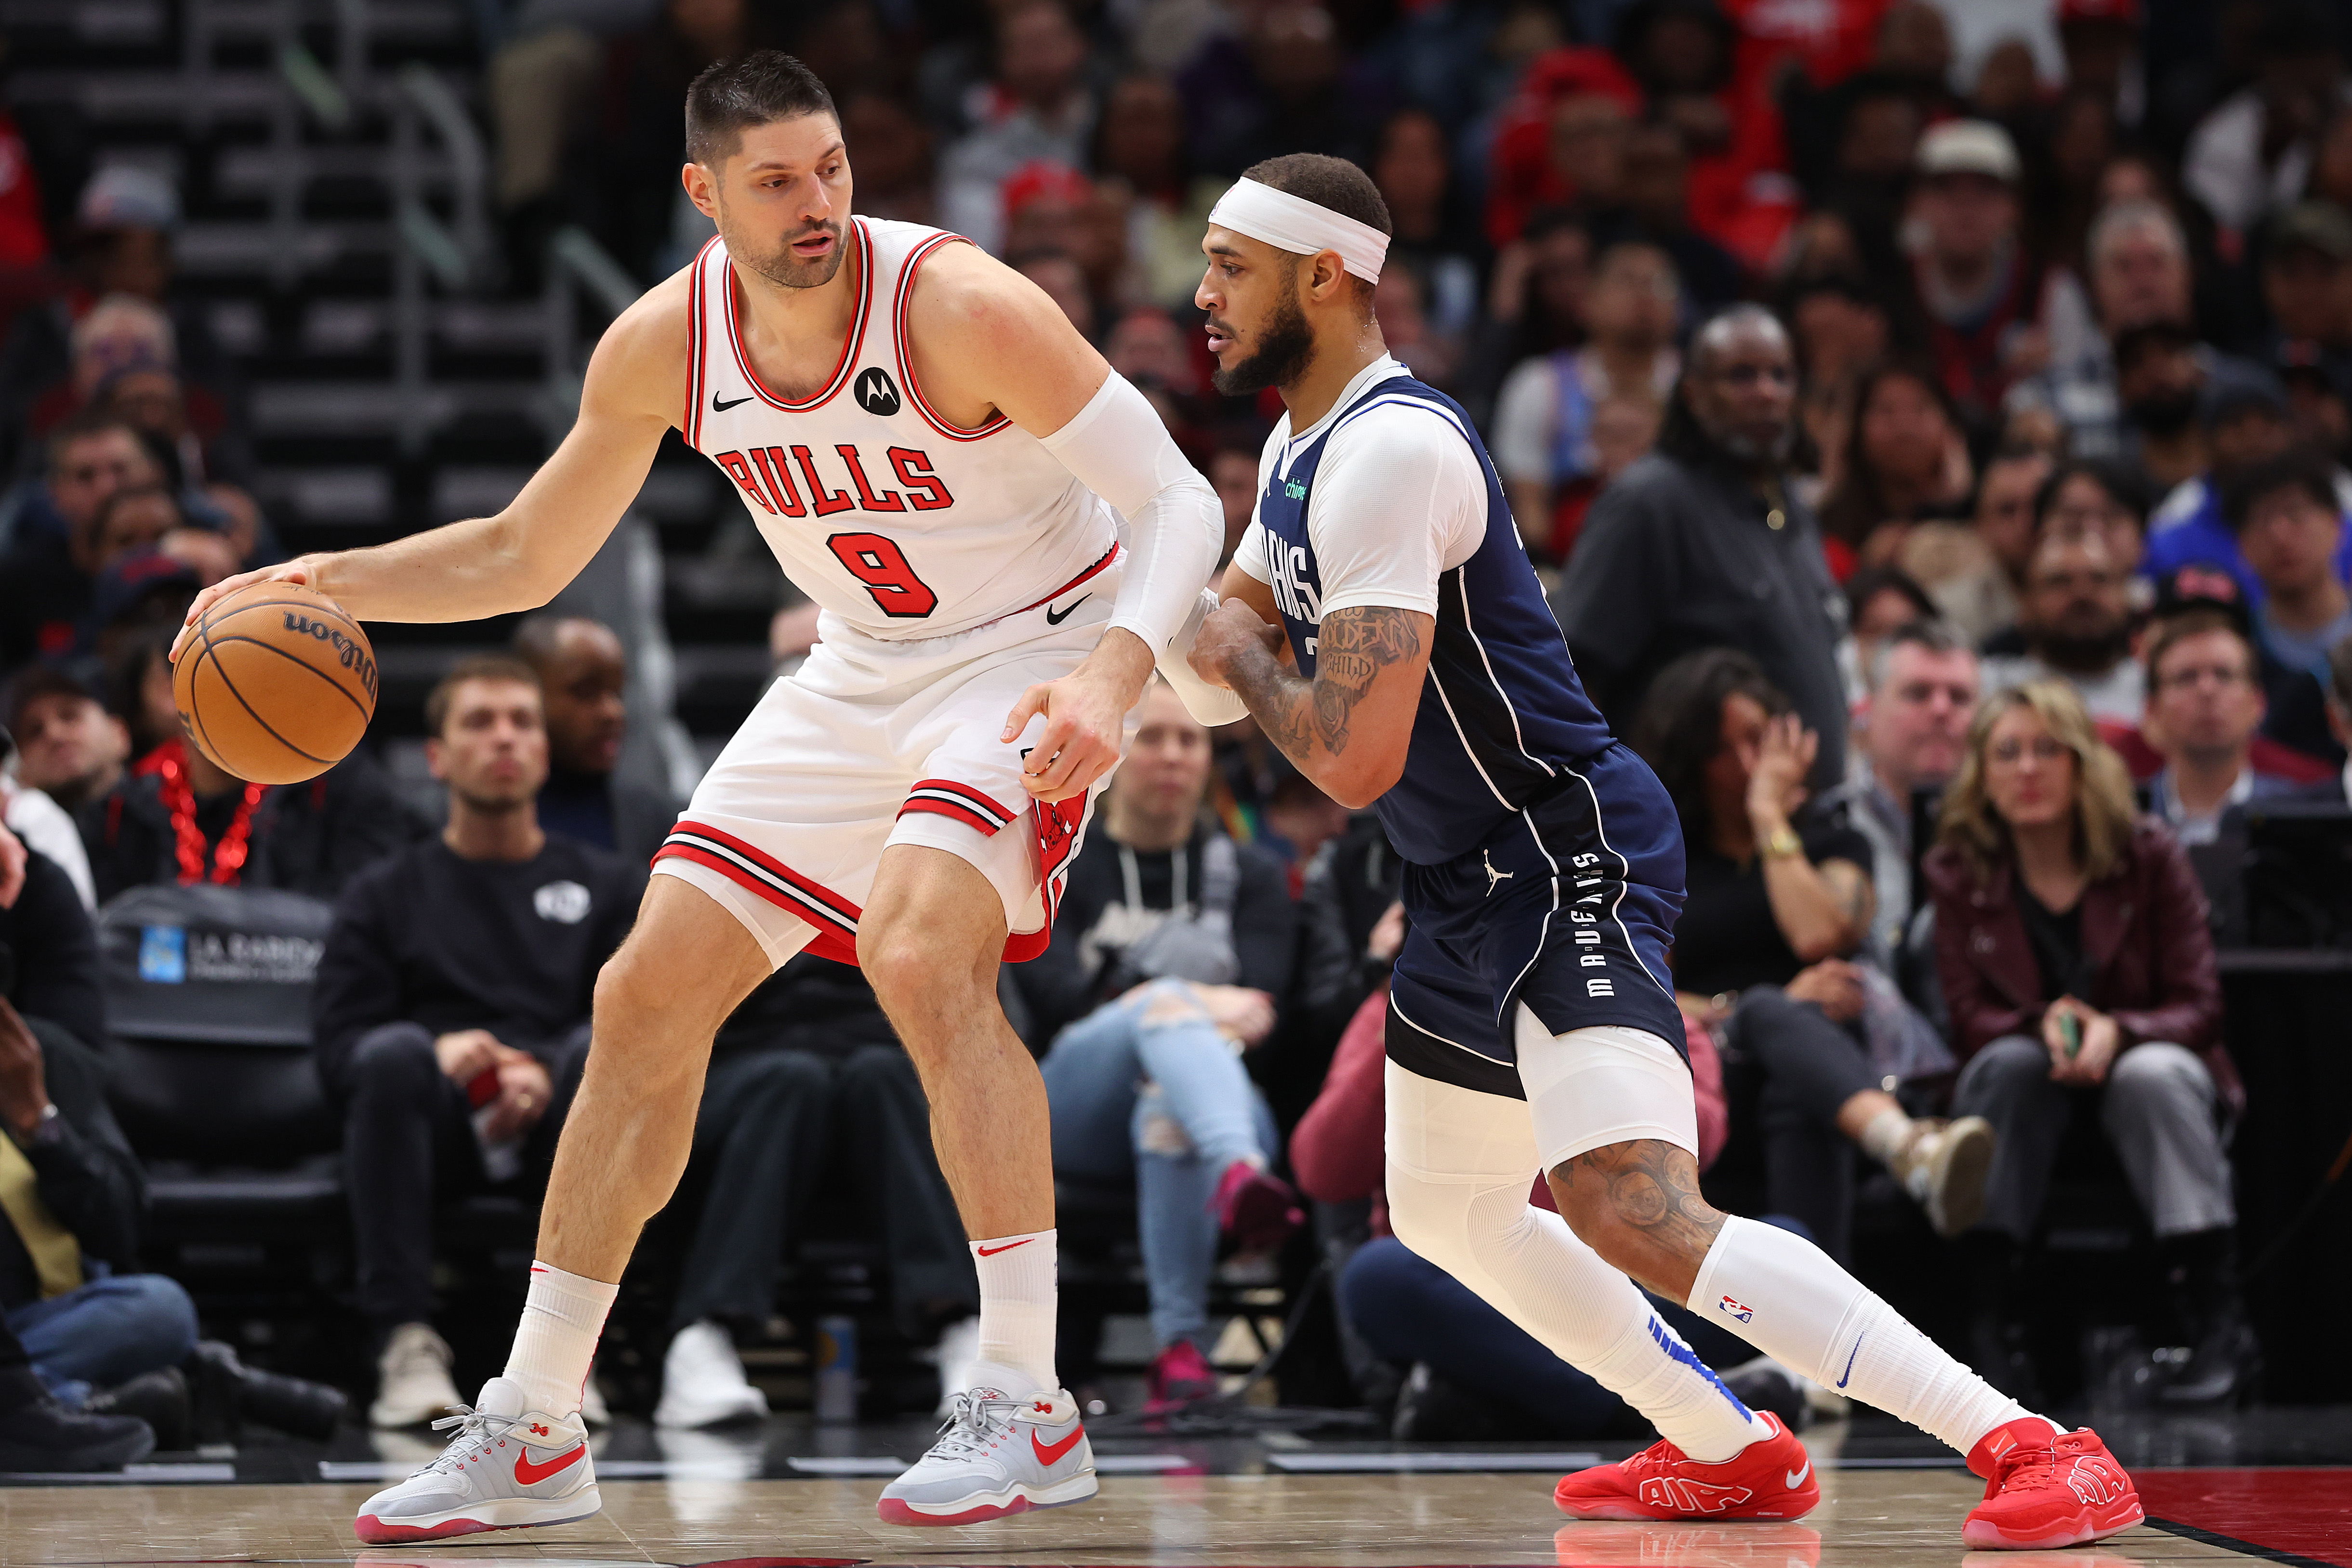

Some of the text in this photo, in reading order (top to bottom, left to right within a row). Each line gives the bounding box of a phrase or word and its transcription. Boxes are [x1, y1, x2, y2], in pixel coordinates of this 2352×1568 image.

[715, 444, 954, 518] BULLS
[826, 532, 938, 618] 9
[283, 611, 377, 705] Wilson
[1571, 853, 1615, 998] MAVEIS
[1742, 1313, 1751, 1323] NBA
[1639, 1476, 1753, 1513] AIR
